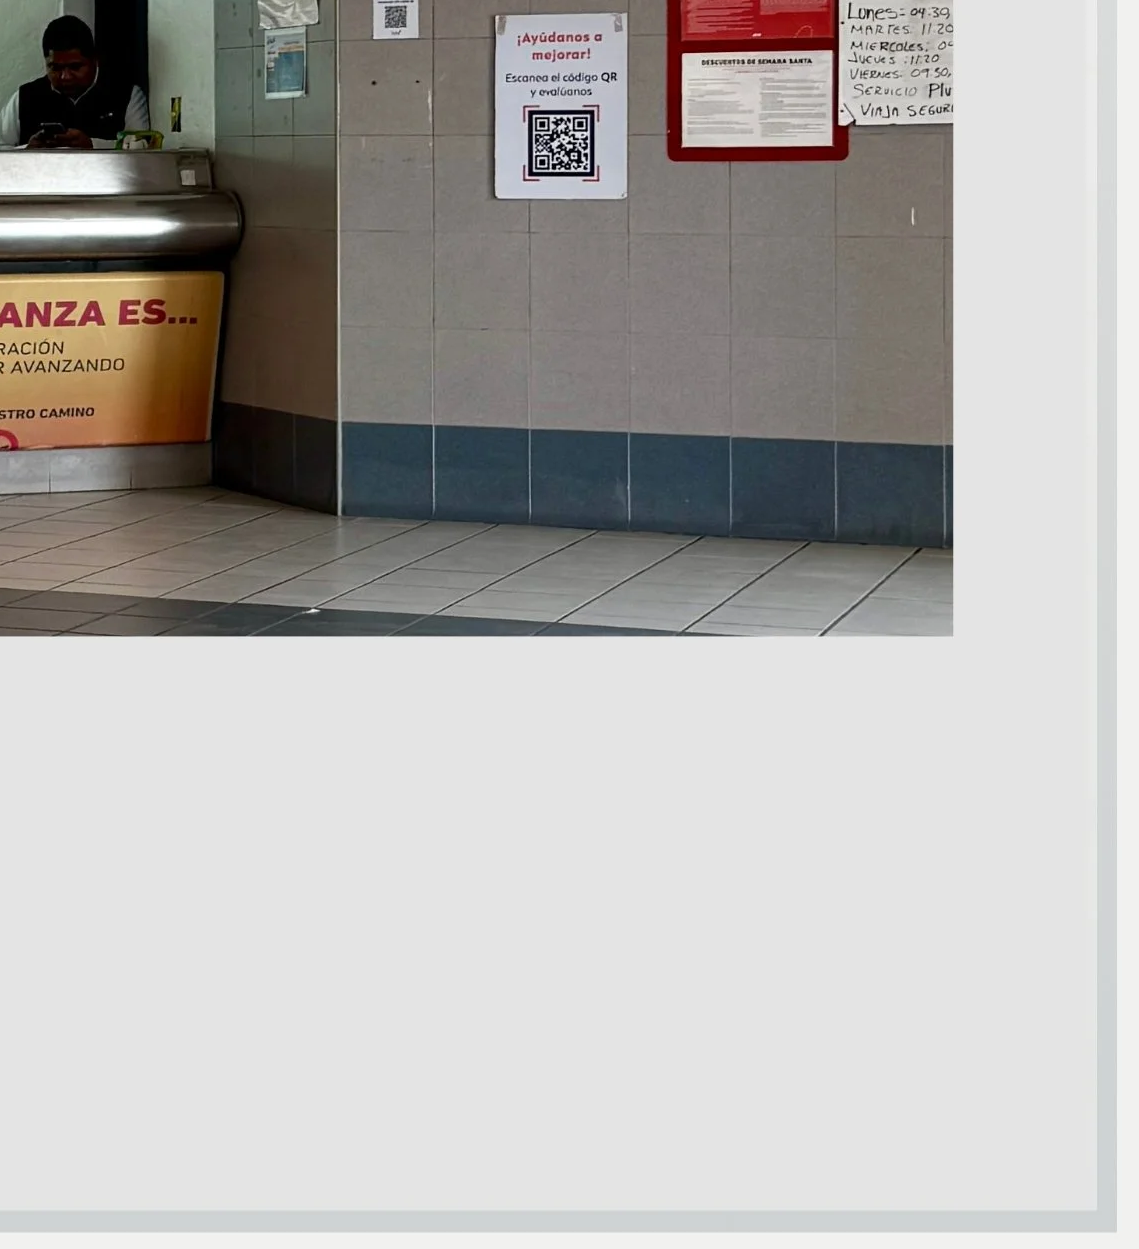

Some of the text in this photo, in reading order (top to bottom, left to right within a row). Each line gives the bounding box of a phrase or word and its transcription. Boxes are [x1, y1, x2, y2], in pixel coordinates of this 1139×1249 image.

[517, 32, 603, 46] ¡Ayúdanos a
[532, 48, 591, 62] mejorar!
[506, 72, 617, 84] Escanea el código QR
[530, 86, 592, 98] y evalúanos
[118, 298, 198, 325] ES...
[11, 357, 125, 374] AVANZANDO
[39, 407, 95, 419] CAMINO
